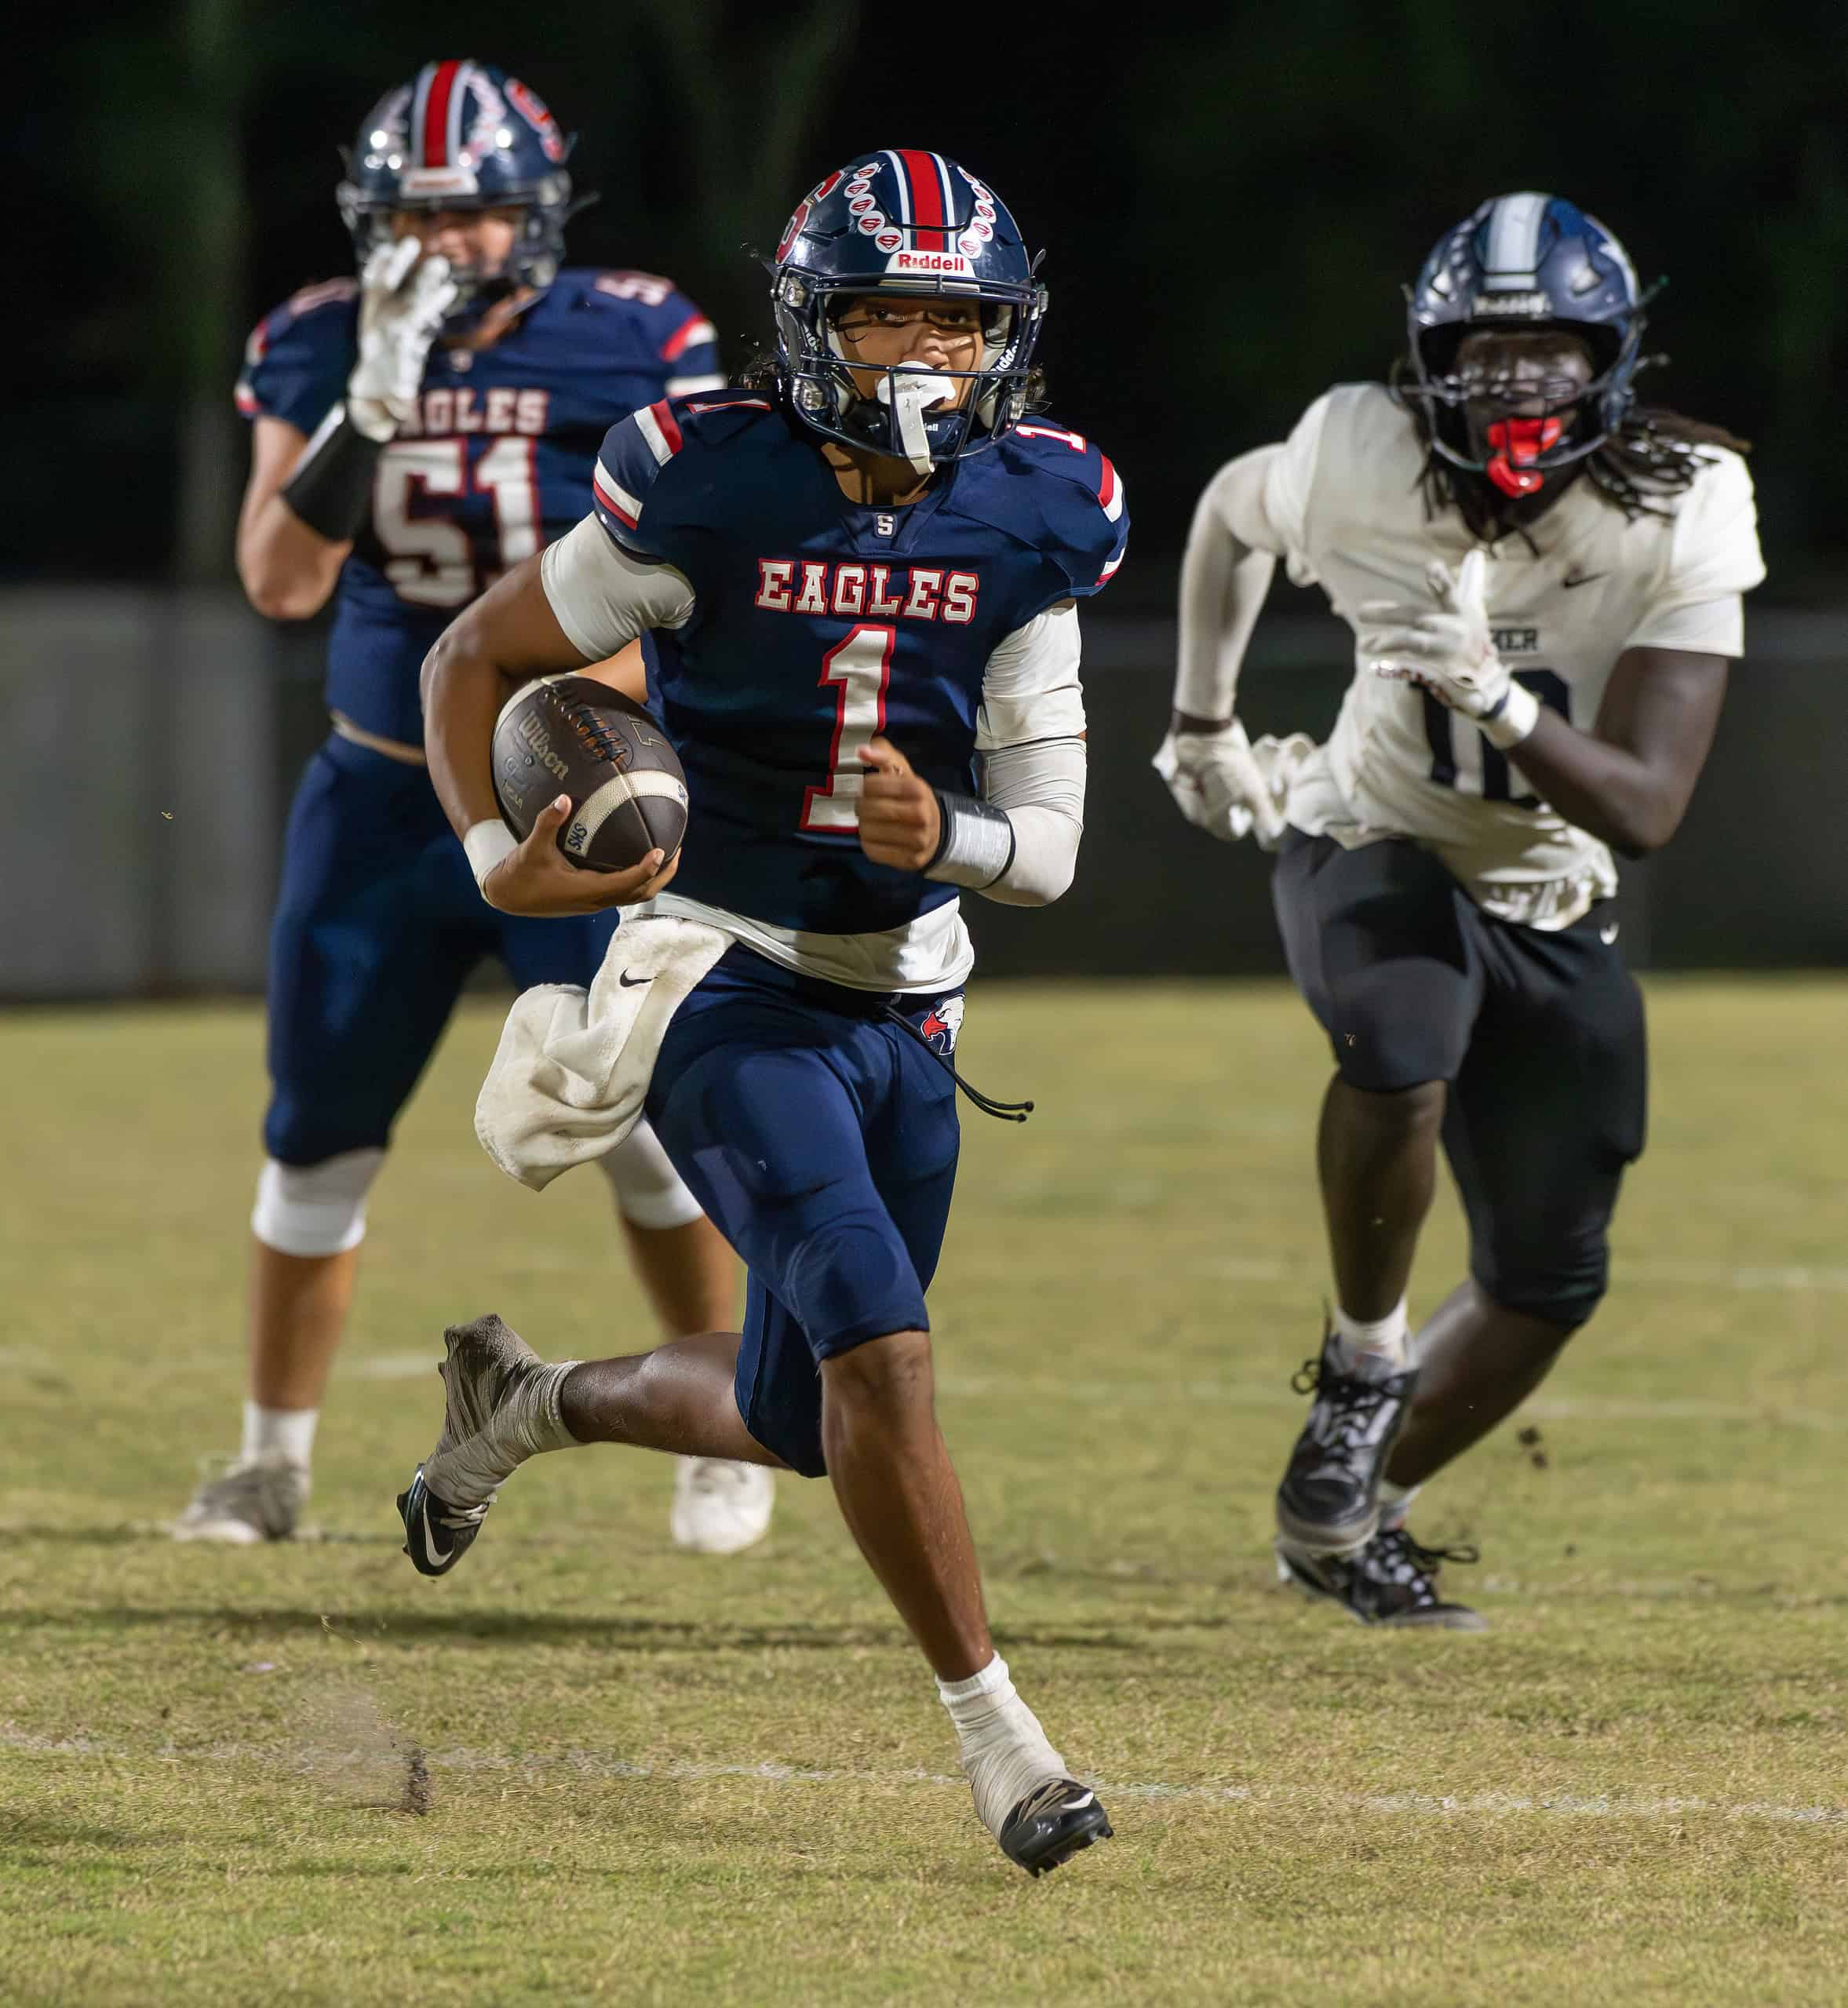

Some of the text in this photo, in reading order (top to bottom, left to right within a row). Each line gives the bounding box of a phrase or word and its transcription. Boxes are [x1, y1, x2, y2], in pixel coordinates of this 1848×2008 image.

[898, 253, 964, 271] Riddell
[373, 437, 548, 607] 51
[877, 514, 895, 536] S
[755, 558, 979, 625] EAGLES
[800, 623, 897, 834] 1
